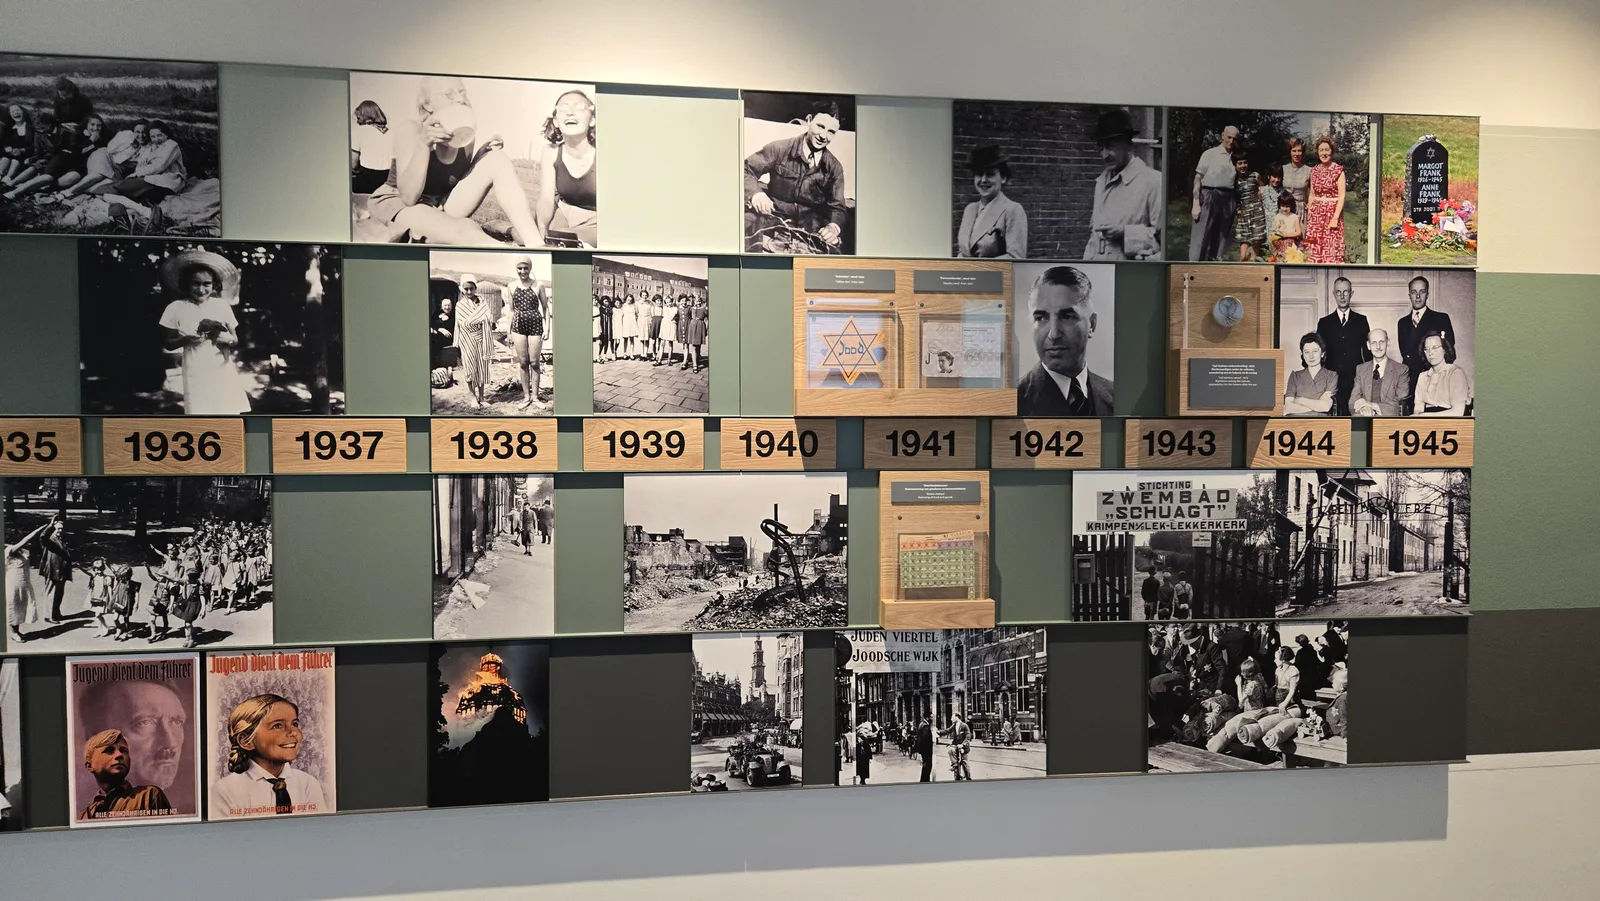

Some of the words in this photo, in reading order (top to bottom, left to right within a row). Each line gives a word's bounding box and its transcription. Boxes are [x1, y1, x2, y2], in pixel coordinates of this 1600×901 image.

[838, 340, 864, 356] Jood
[925, 353, 931, 365] J
[0, 431, 58, 462] 35
[124, 431, 222, 462] 1936
[295, 431, 384, 460] 1937
[450, 430, 538, 460] 1938
[603, 430, 685, 458] 1939
[739, 430, 819, 458] 1940
[885, 430, 956, 457] 1941
[1009, 430, 1084, 458] 1942
[1142, 430, 1217, 457] 1943
[1263, 430, 1335, 457] 1944
[1388, 430, 1458, 456] 1945
[1102, 489, 1230, 505] ZWEMBAD
[1139, 481, 1191, 490] STICHTING
[851, 630, 887, 642] JUDEN
[893, 632, 938, 643] VIERTEL
[209, 653, 248, 676] Jugend
[250, 651, 276, 672] dient
[277, 651, 300, 671] dem
[300, 649, 333, 672] Führer
[853, 649, 911, 662] JOODSCHE
[913, 651, 939, 662] WIJK
[73, 663, 110, 684] Jugend
[112, 661, 137, 681] dient
[139, 660, 159, 680] dem
[297, 804, 307, 812] DIE
